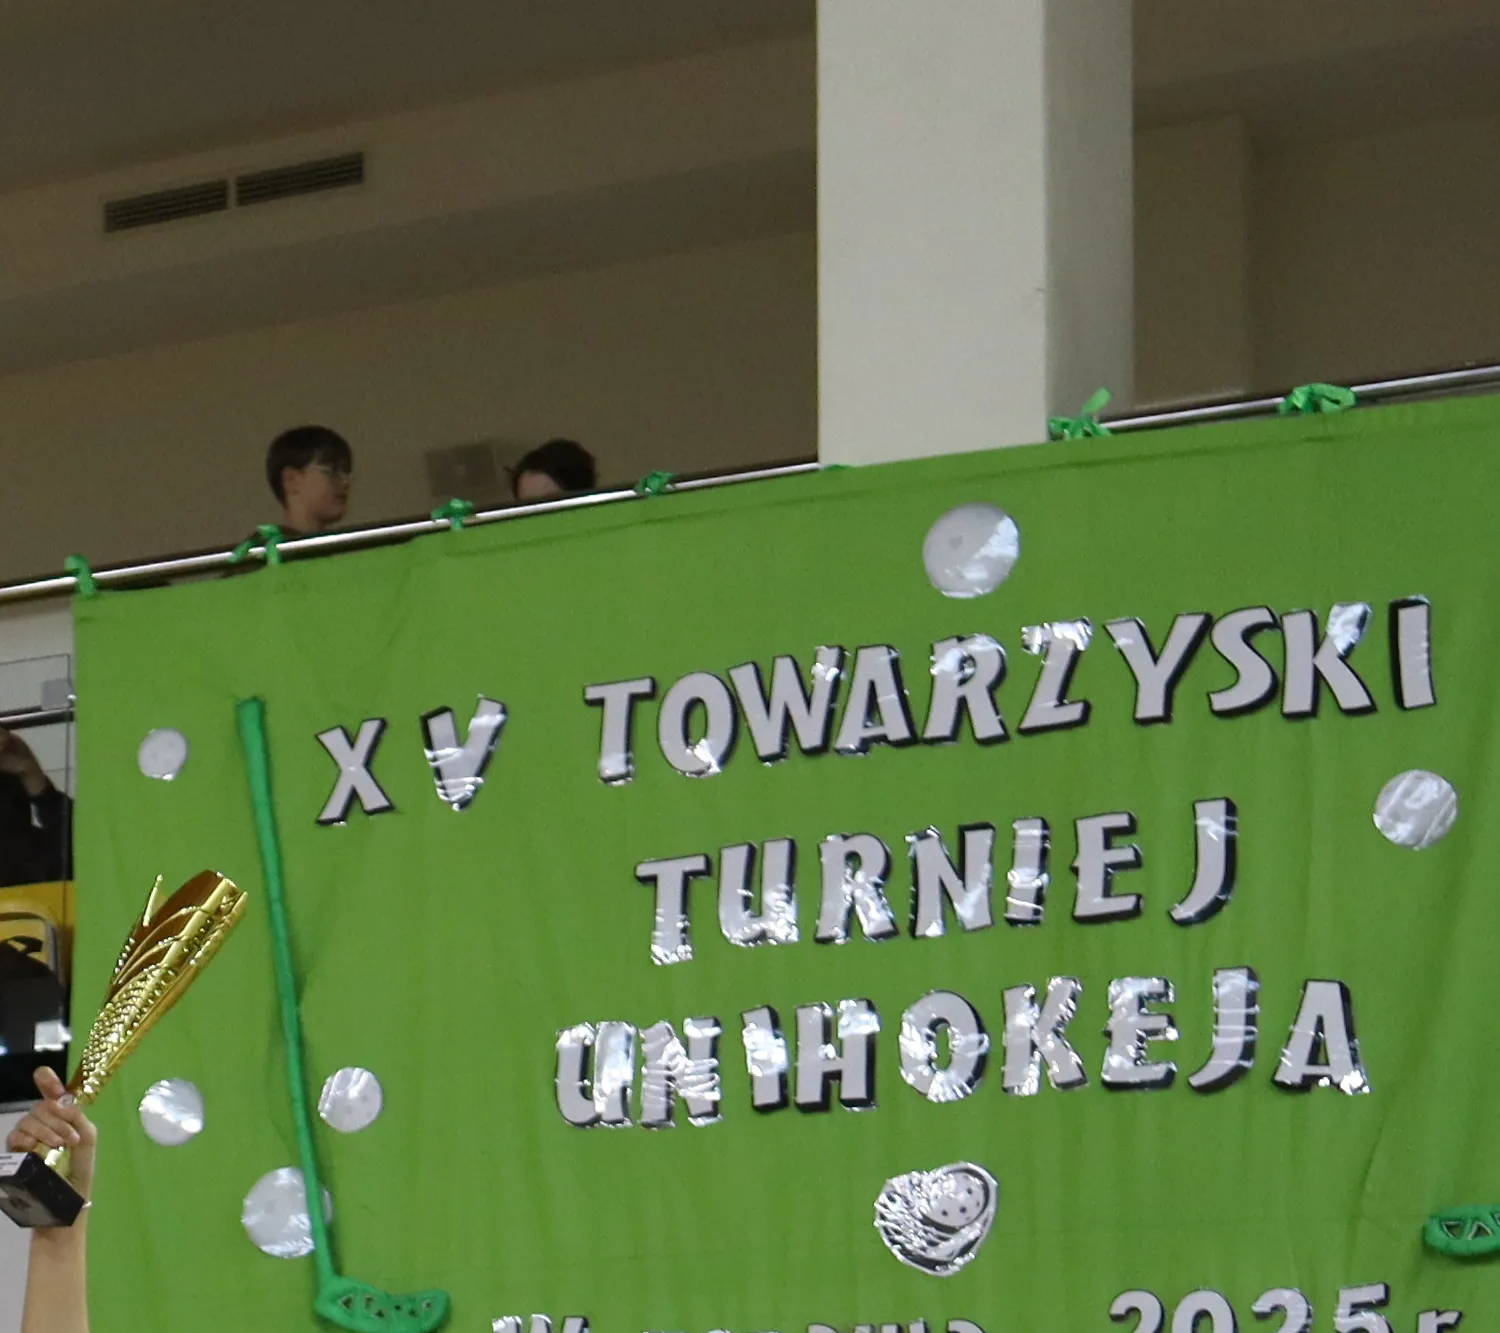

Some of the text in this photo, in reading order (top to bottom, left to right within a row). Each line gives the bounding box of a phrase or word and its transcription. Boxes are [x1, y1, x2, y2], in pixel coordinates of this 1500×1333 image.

[583, 594, 1438, 786] TOWARZYSKI
[634, 797, 1239, 966] TURNIEJ
[554, 966, 1373, 1131] UNIHOKEJA
